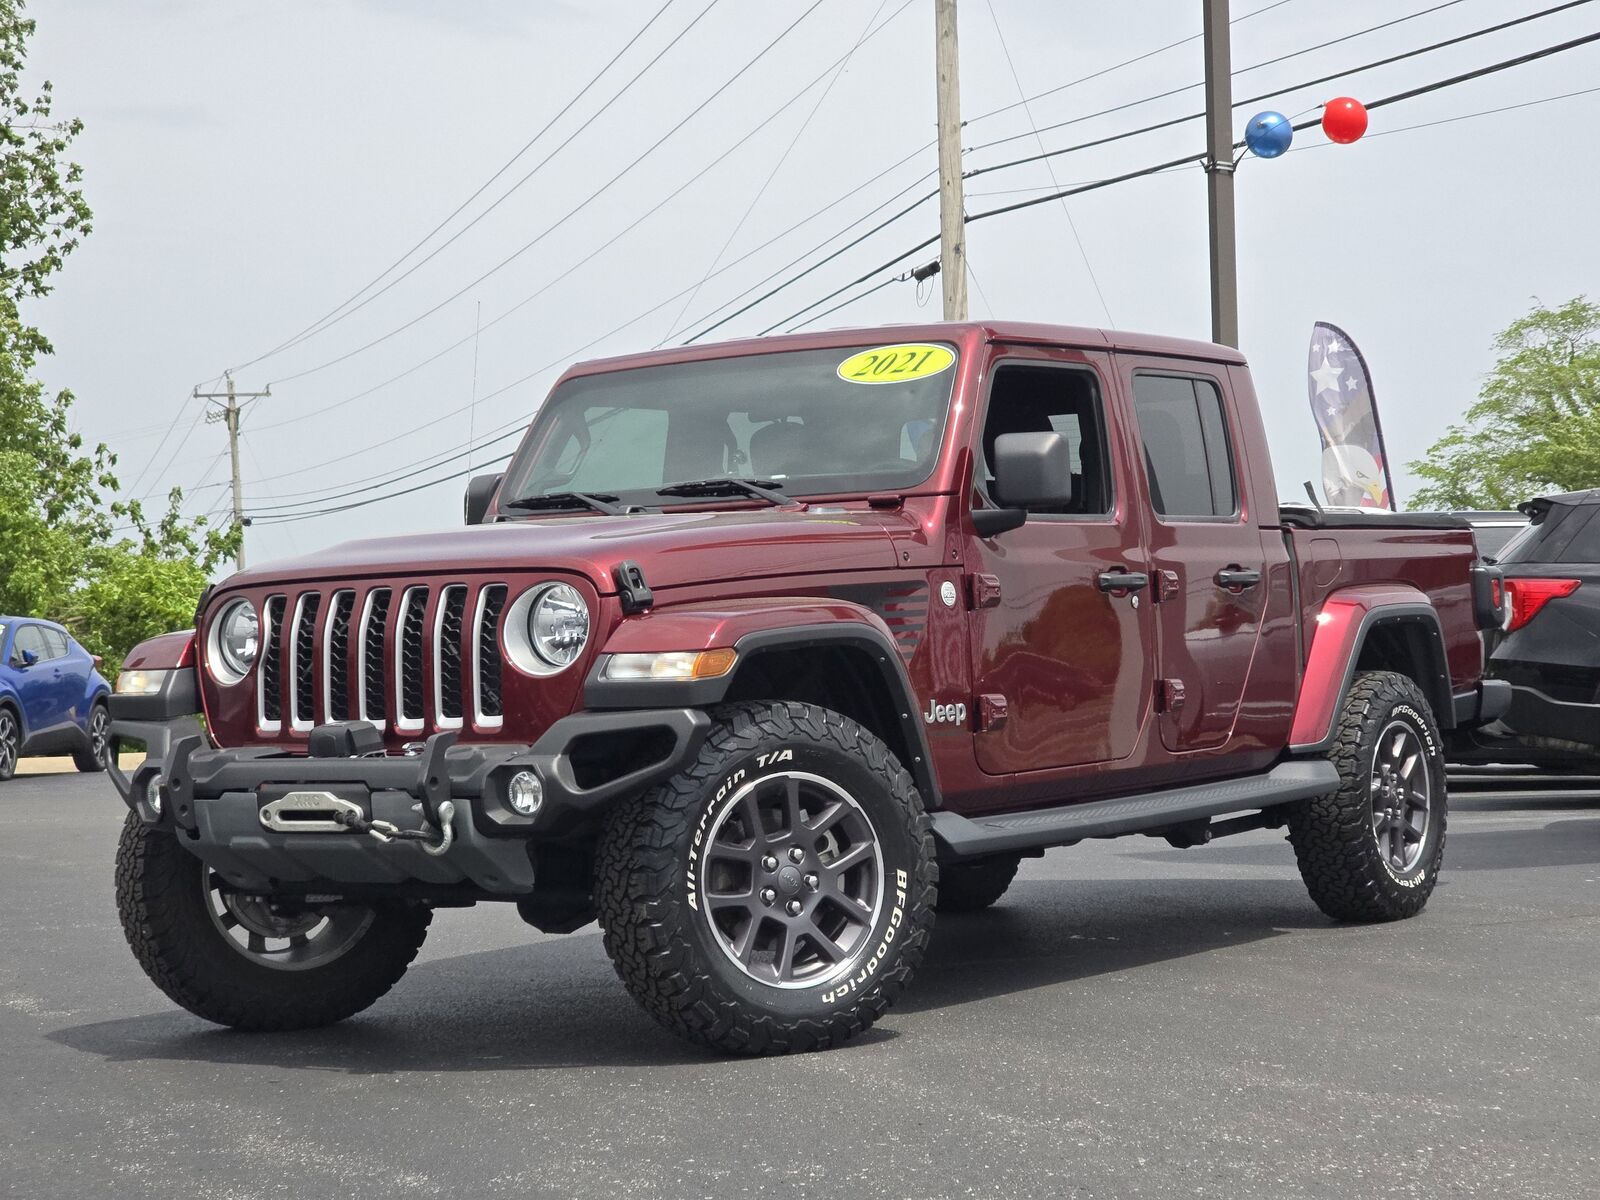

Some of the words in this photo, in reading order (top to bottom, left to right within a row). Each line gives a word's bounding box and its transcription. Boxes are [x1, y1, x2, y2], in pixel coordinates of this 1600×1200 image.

[851, 350, 934, 377] 2021
[924, 699, 966, 725] Jeep
[1391, 705, 1436, 756] BFGoodrich
[687, 769, 746, 911] All-Terrain
[756, 749, 794, 768] T/A
[821, 868, 908, 1004] BFGoodrich
